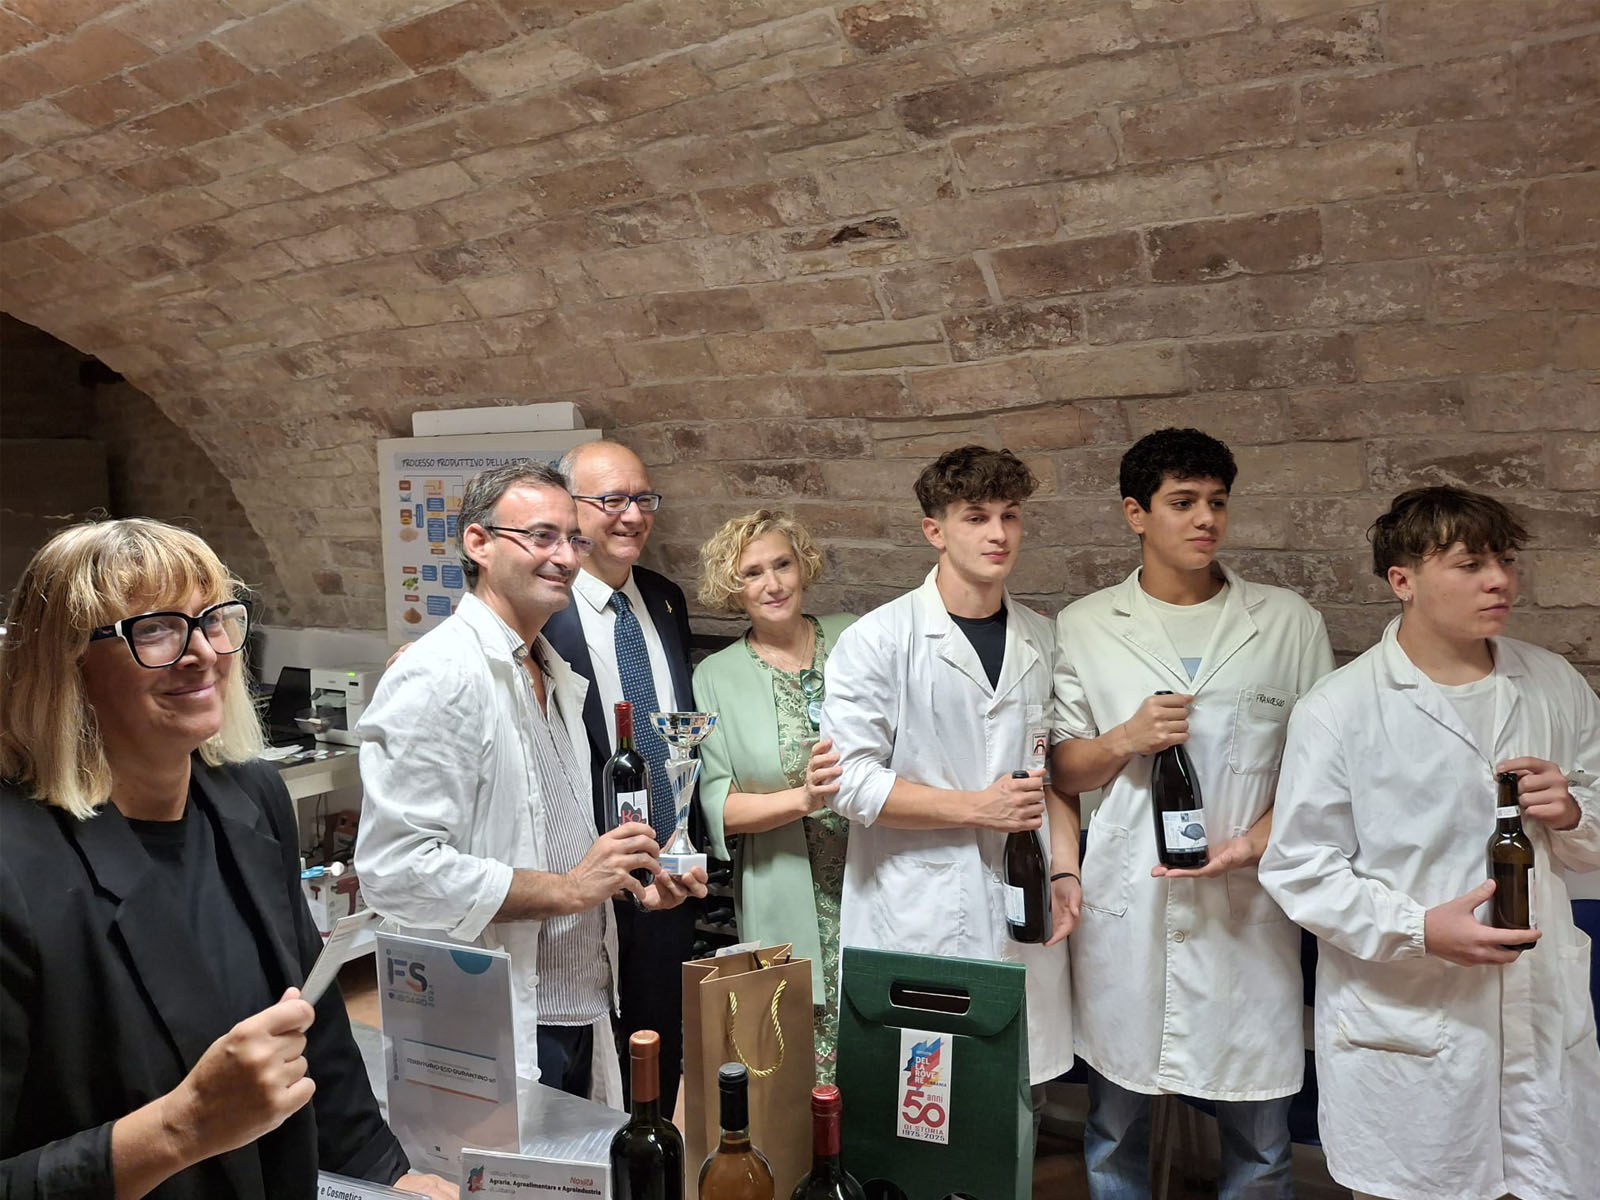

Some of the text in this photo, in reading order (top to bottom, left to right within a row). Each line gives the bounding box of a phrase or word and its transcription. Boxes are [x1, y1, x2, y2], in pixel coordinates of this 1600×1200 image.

[402, 458, 435, 467] PROCESSO
[437, 458, 484, 468] PRODUTTIVO
[486, 458, 510, 467] DELLA
[915, 1056, 930, 1065] DEL
[915, 1063, 925, 1071] LA
[902, 1089, 946, 1128] 50 anni
[914, 1125, 944, 1135] STORIA
[320, 1186, 363, 1200] e Cosmetica
[512, 1180, 557, 1191] Agroalimentare
[562, 1185, 602, 1196] Agroindustria
